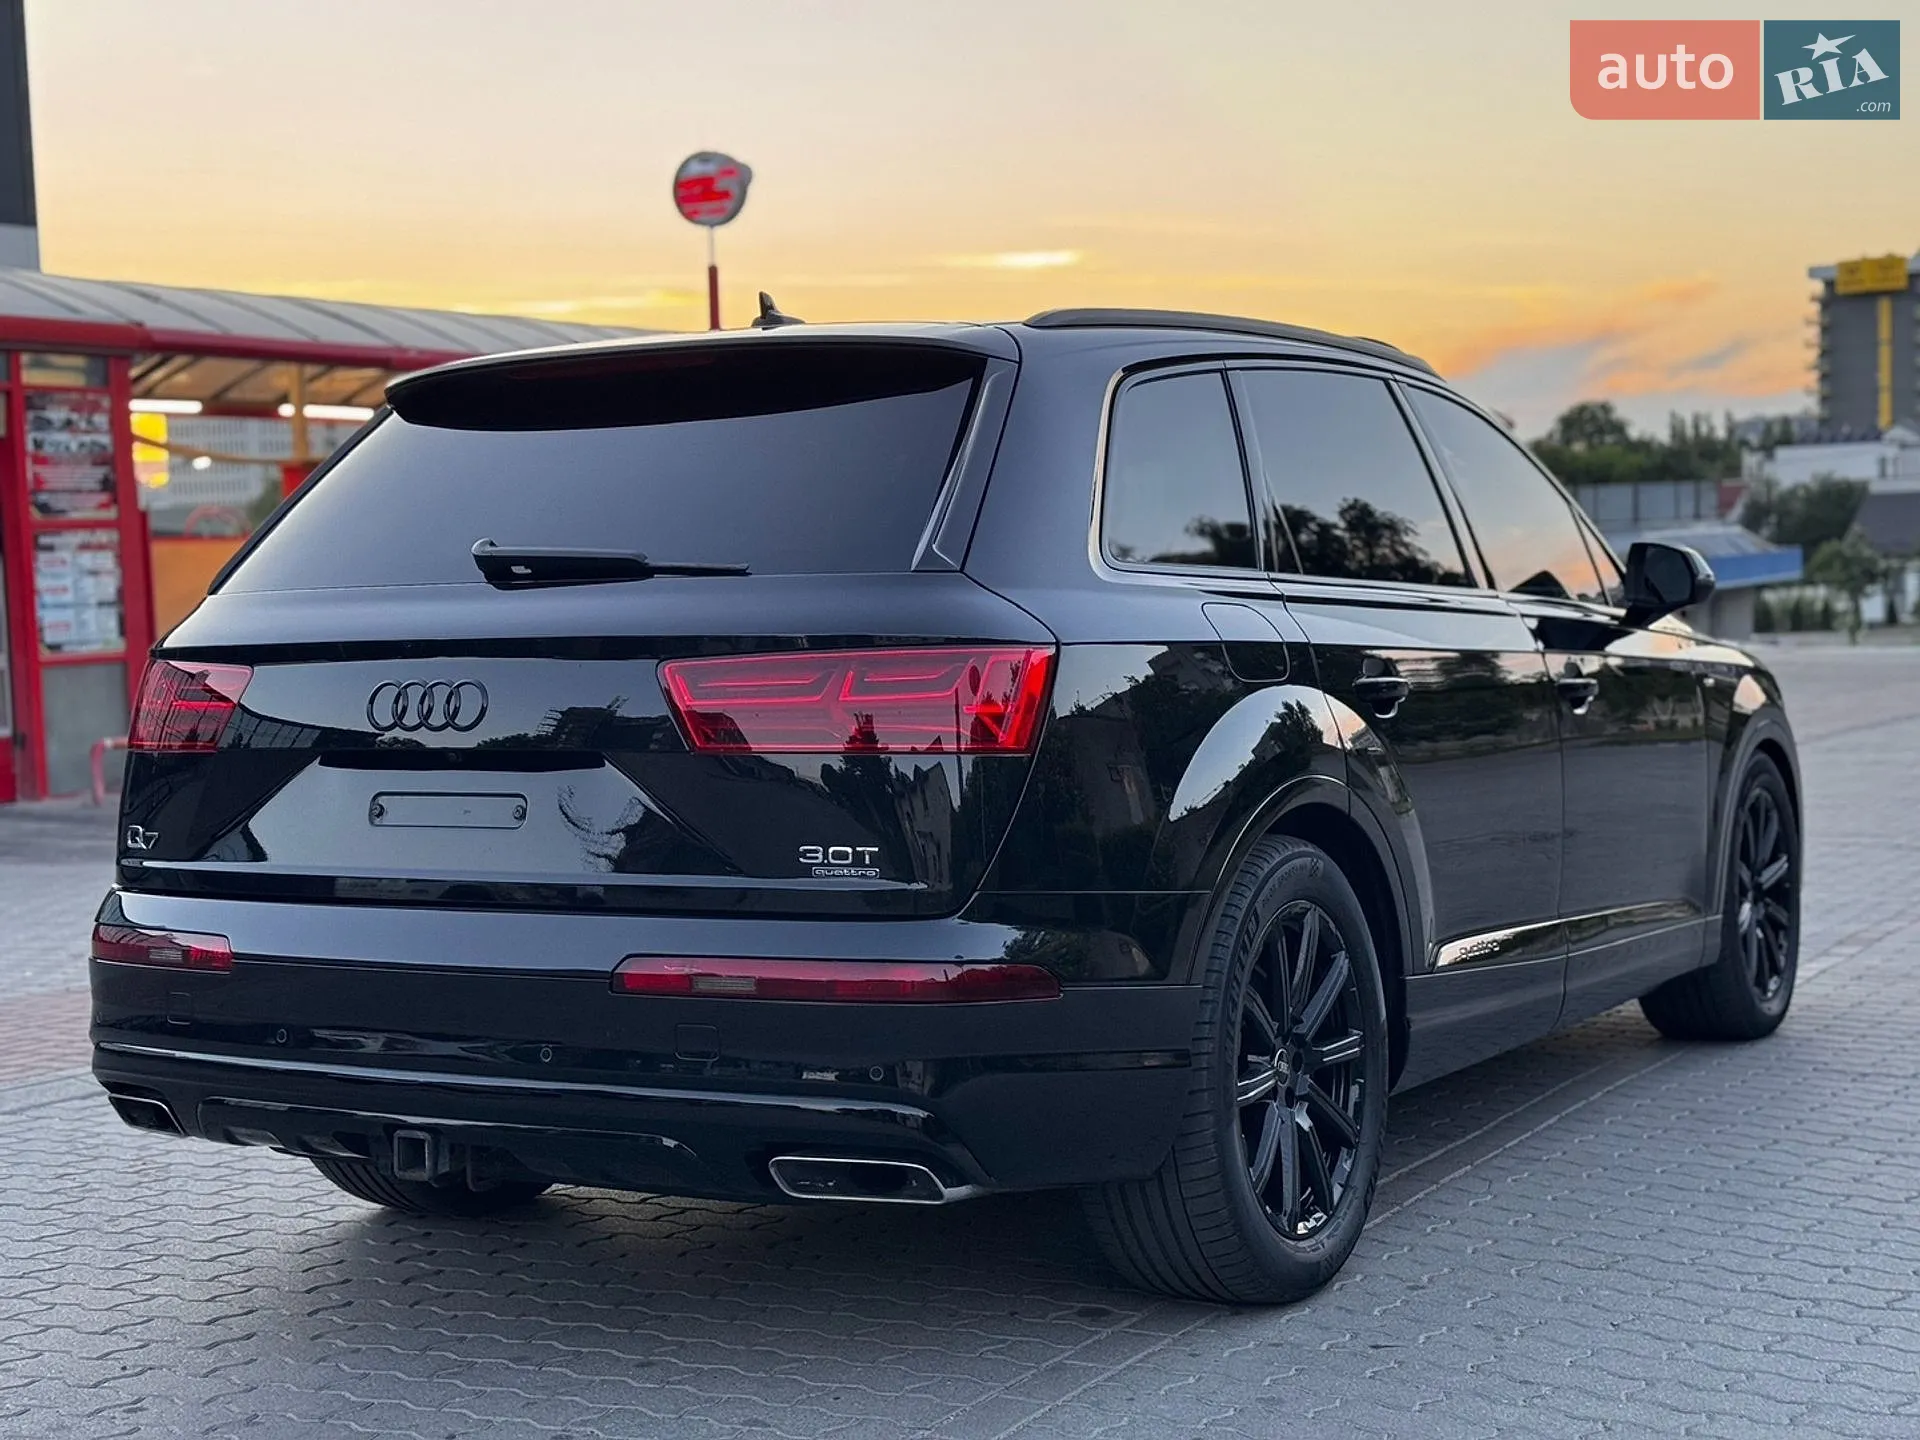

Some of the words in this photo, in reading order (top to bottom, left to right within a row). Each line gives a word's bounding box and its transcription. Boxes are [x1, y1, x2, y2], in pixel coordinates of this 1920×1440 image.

[126, 825, 159, 850] Q7
[798, 845, 879, 864] 3.0T
[814, 868, 877, 877] quattro
[1458, 939, 1501, 958] quattro
